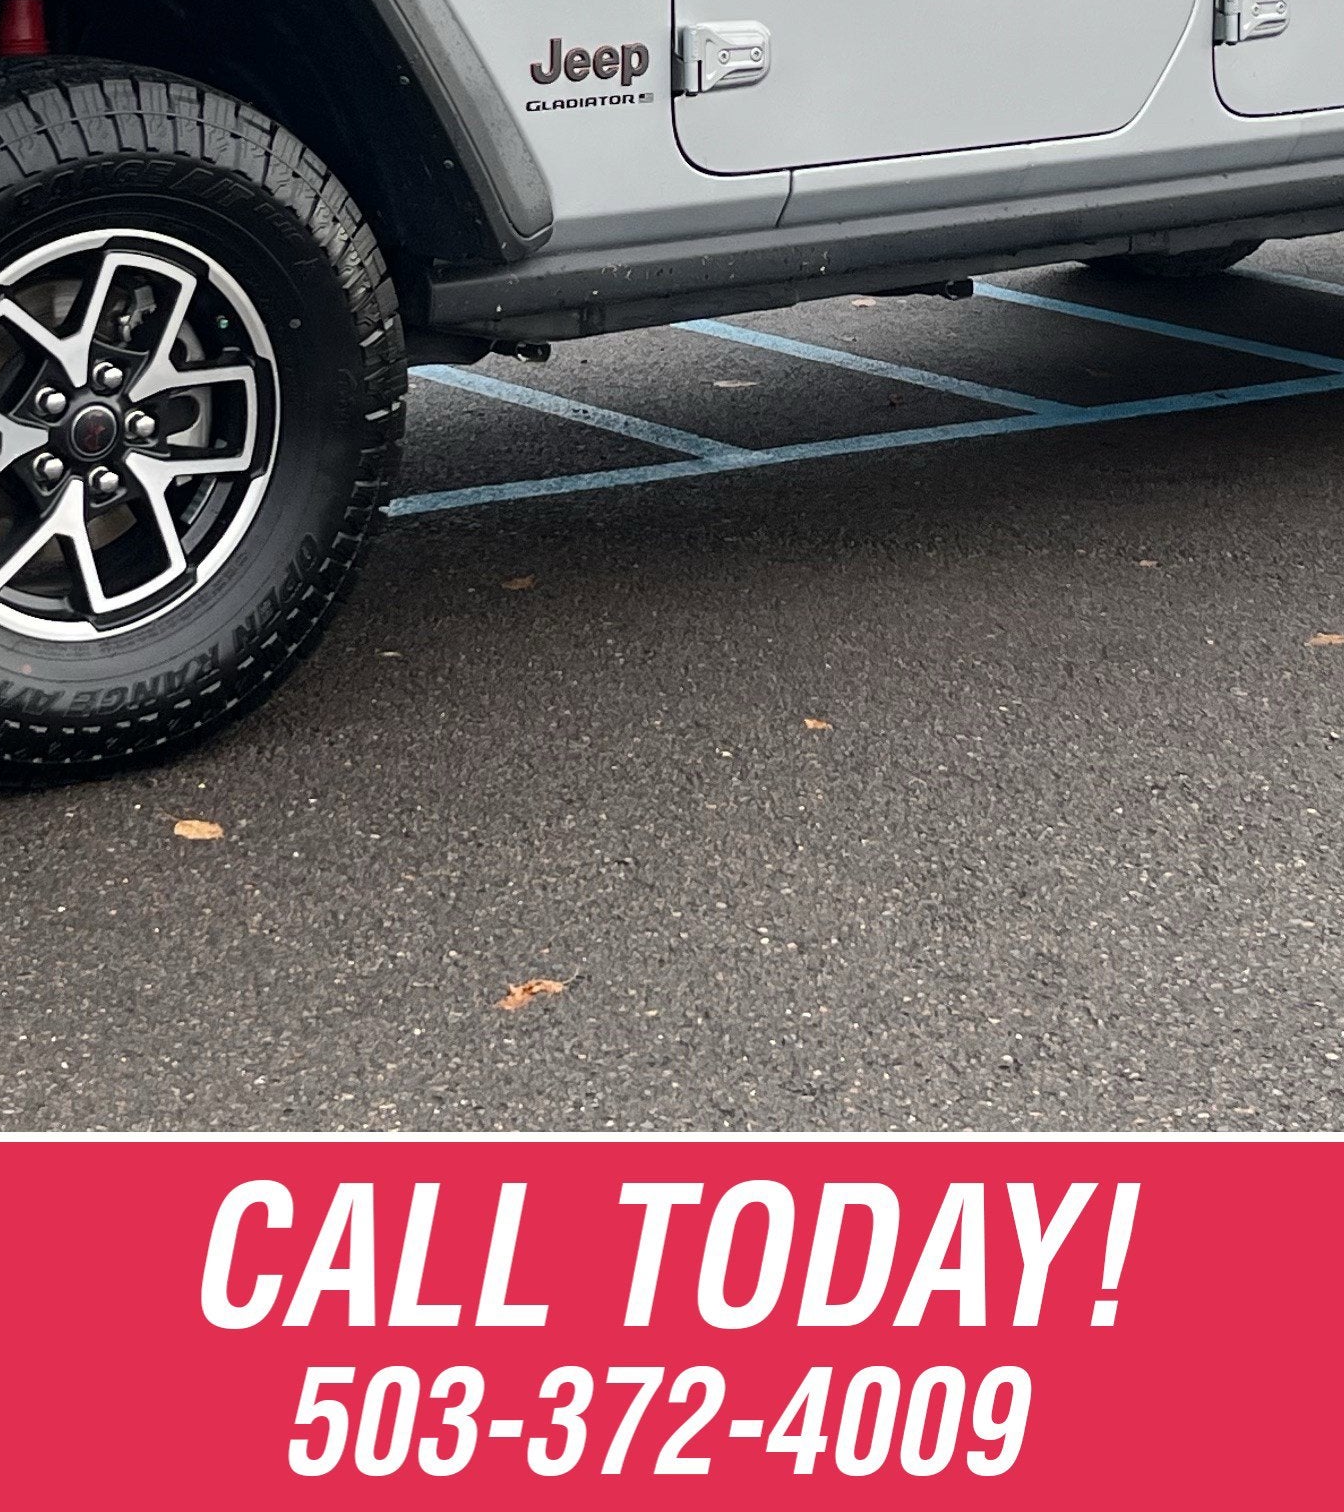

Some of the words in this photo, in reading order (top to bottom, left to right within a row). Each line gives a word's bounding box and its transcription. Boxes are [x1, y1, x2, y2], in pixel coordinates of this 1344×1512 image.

[529, 37, 650, 87] Jeep
[525, 93, 636, 112] GLADIATOR
[60, 642, 221, 719] RANGE
